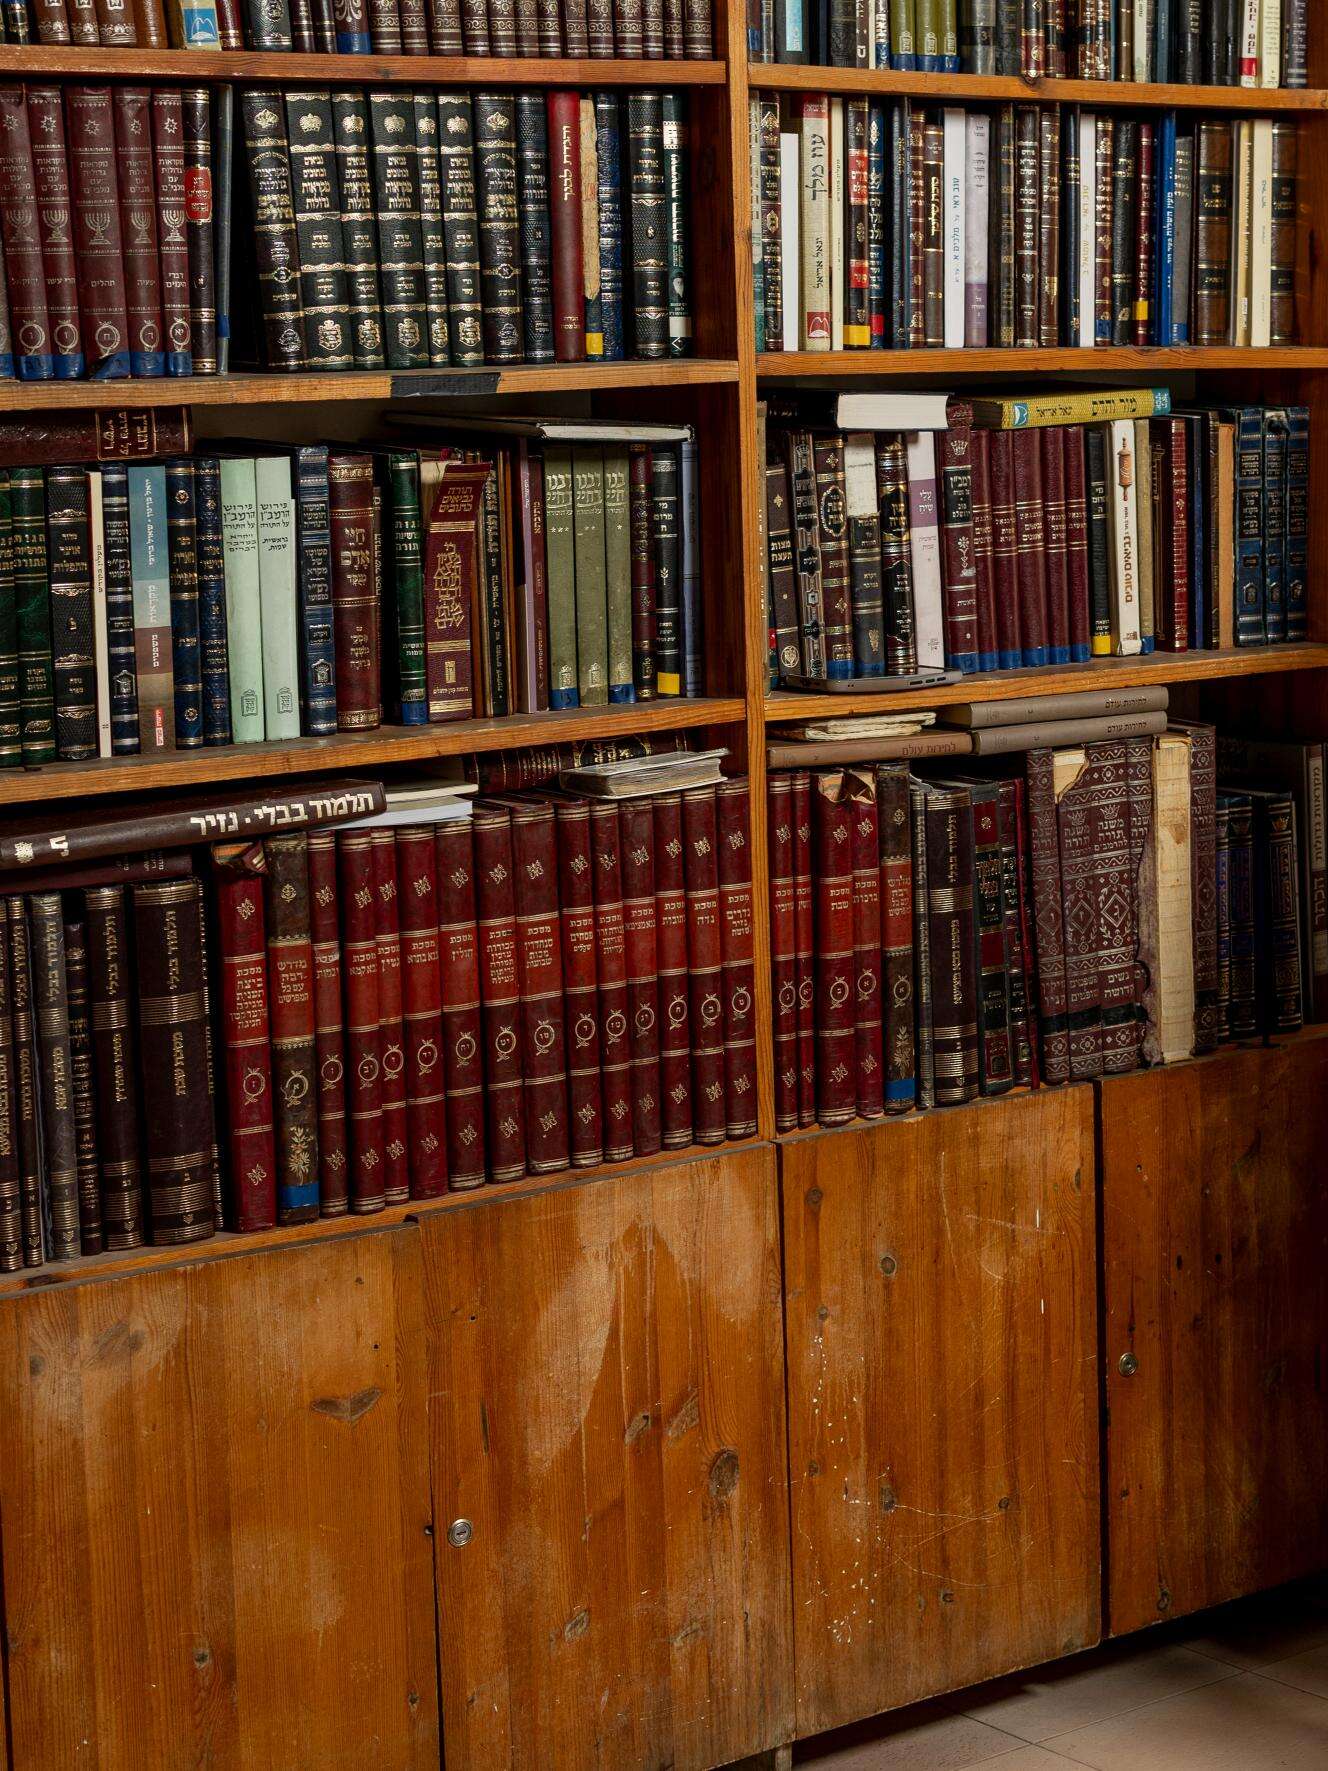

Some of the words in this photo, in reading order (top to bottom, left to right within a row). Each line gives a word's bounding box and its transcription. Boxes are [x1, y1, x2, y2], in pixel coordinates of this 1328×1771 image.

[810, 134, 826, 158] עוז
[559, 168, 575, 201] לבנך
[805, 164, 828, 200] מלך
[951, 227, 960, 251] מלכים
[812, 260, 824, 289] אריאל
[448, 486, 473, 495] תורה
[442, 495, 474, 504] נביאים
[223, 503, 253, 512] פירוש
[260, 502, 288, 511] פירוש
[439, 503, 473, 513] כתובים
[223, 511, 255, 522] הרמב"ן
[260, 510, 290, 521] הרמב"ן
[223, 523, 246, 531] התורה
[260, 522, 280, 530] התורה
[1123, 536, 1133, 571] נביאים
[1124, 573, 1134, 603] טובים
[150, 634, 159, 668] משפטים
[902, 744, 925, 758] עולם
[1312, 766, 1322, 818] מקראות
[308, 791, 375, 820] תלמוד
[254, 804, 308, 826] בבלי
[190, 812, 239, 836] נזיר
[1098, 817, 1124, 830] משנה
[1099, 830, 1124, 841] תורה
[1313, 821, 1323, 862] גדולות
[854, 880, 878, 889] מסכת
[830, 887, 851, 897] מסכת
[728, 894, 750, 903] מסכת
[852, 893, 880, 904] ברכות
[1313, 877, 1325, 925] הכתר
[694, 901, 717, 911] מסכת
[830, 901, 850, 911] שבת
[631, 908, 654, 918] מסכת
[726, 908, 751, 920] נדרים
[569, 918, 593, 928] מסכת
[600, 914, 622, 924] מסכת
[697, 915, 716, 926] נדה
[163, 910, 178, 954] תלמוד
[527, 925, 552, 936] מסכת
[449, 934, 473, 944] מסכת
[570, 931, 594, 942] פסחים
[411, 940, 436, 950] מסכת
[524, 938, 554, 951] סנהדרין
[451, 947, 473, 961] חולין
[529, 949, 550, 960] מכות
[277, 959, 307, 971] מדרש
[168, 957, 180, 990] בבלי
[236, 966, 262, 977] מסכת
[1108, 970, 1130, 983] נשים
[1104, 984, 1134, 999] קדושה
[278, 993, 309, 1004] המפרשים
